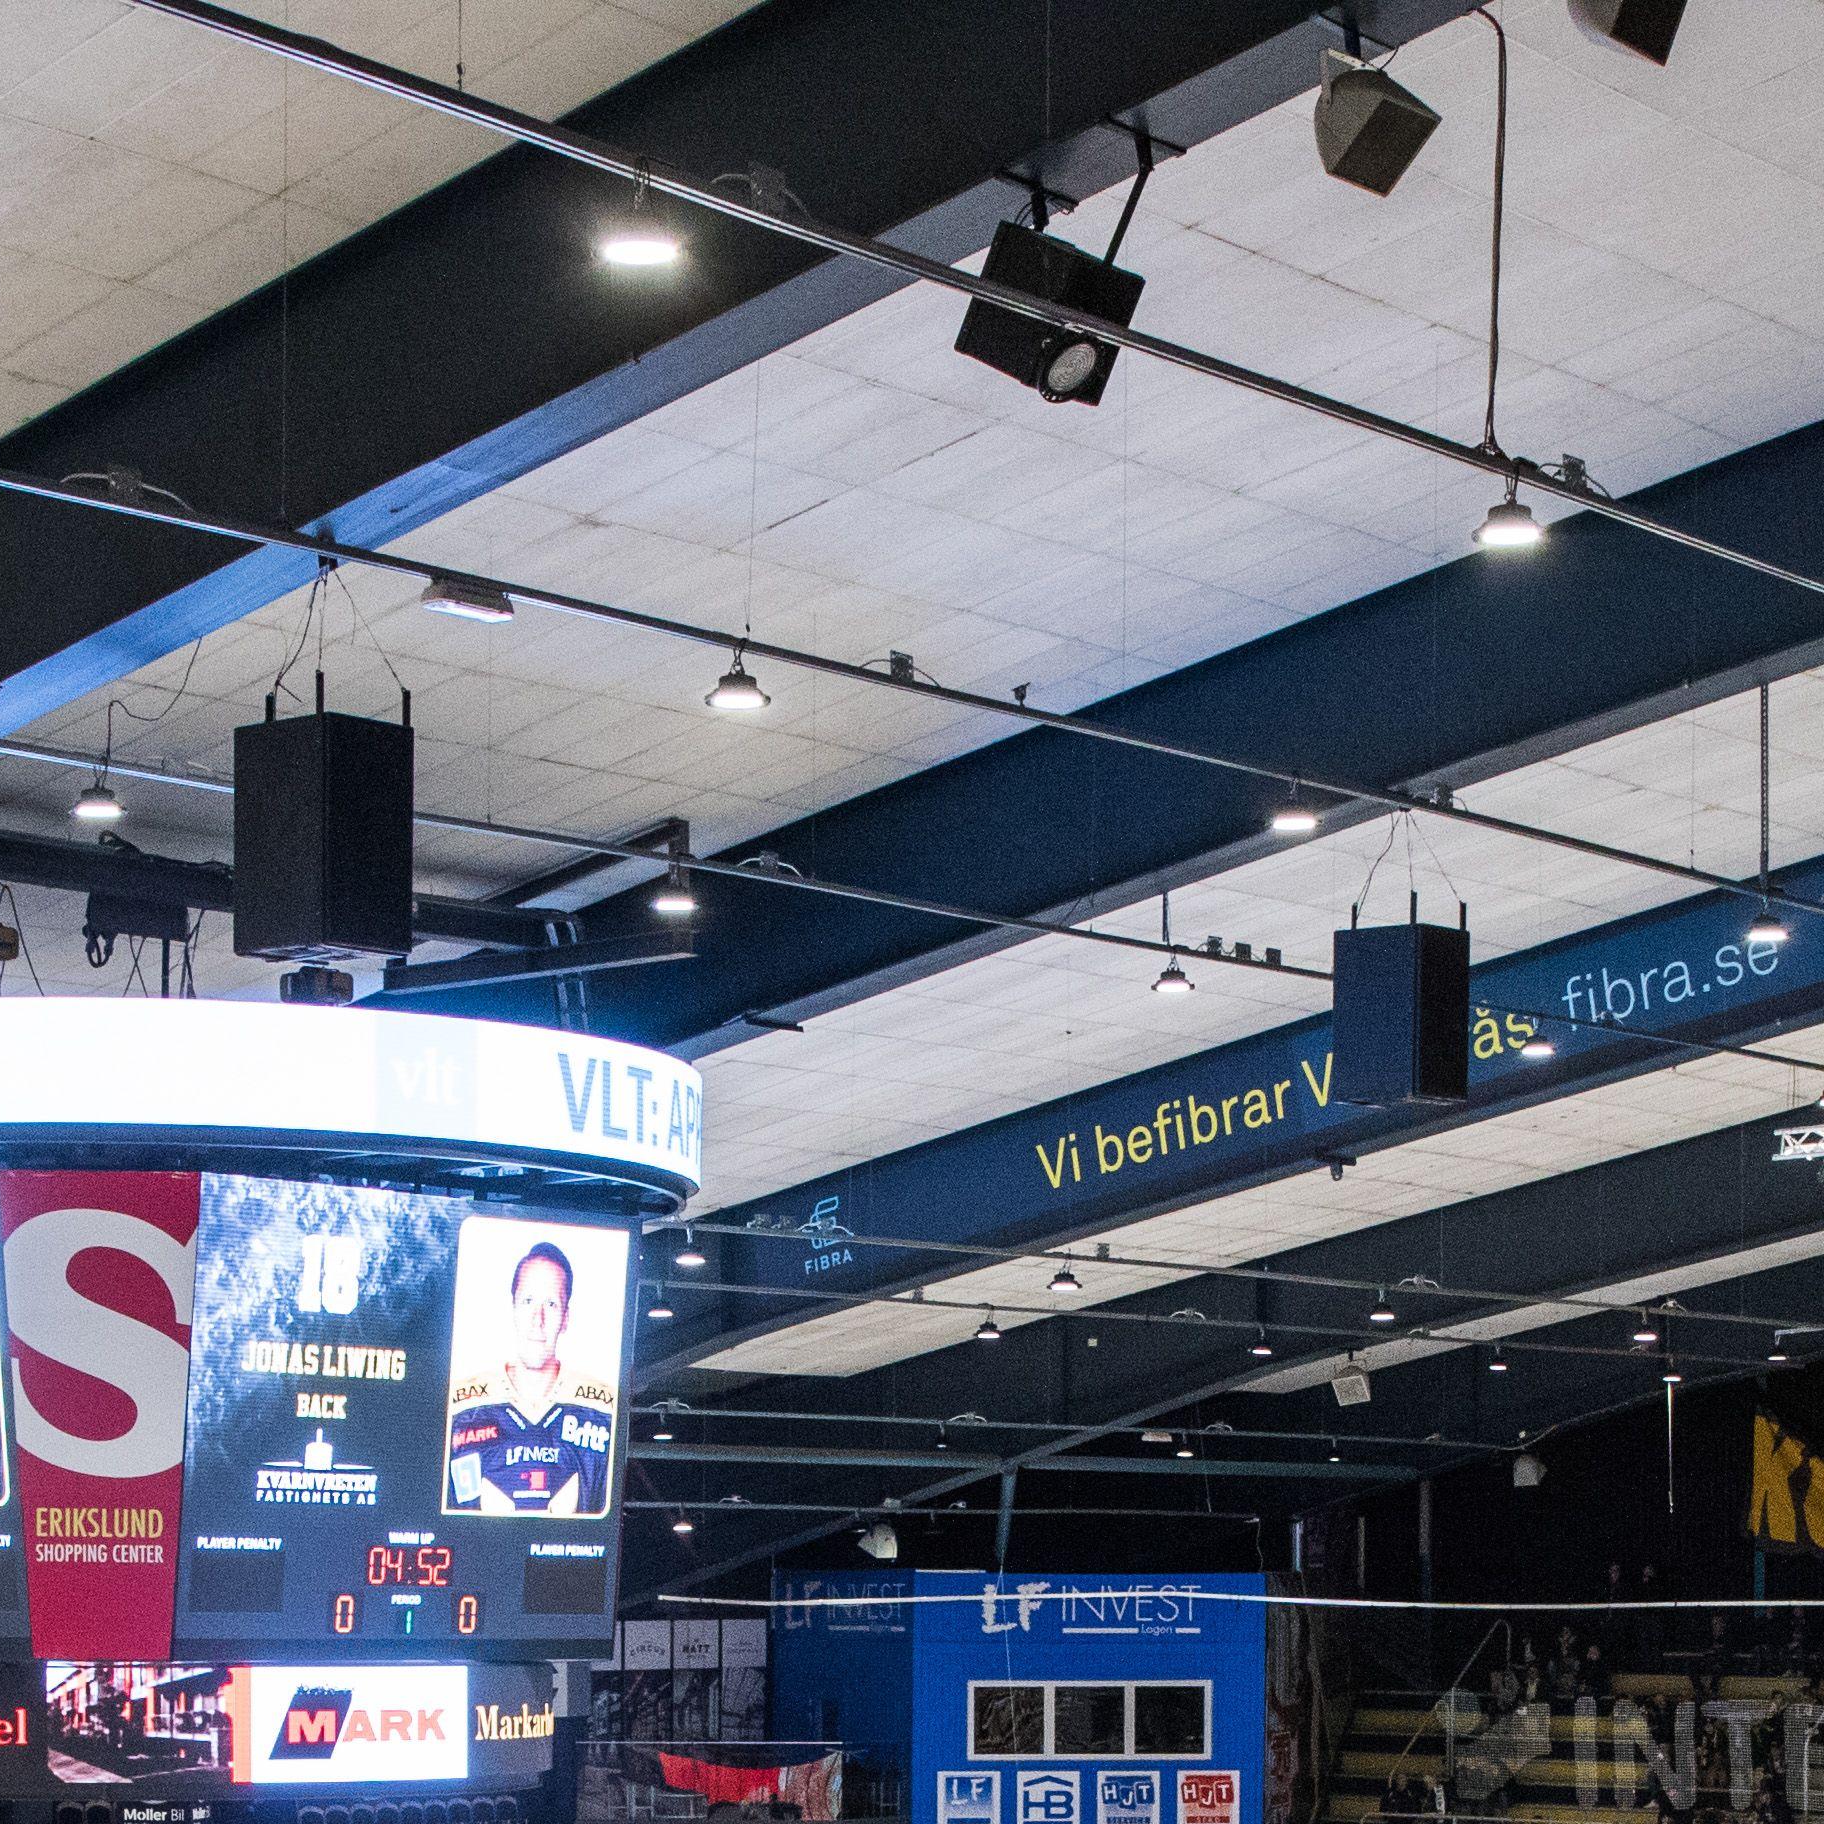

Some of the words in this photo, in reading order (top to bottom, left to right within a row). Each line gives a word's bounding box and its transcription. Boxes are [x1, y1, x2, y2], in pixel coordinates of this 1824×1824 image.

[1561, 934, 1780, 1034] fibra.se
[558, 1053, 657, 1146] VLT:
[1036, 1134, 1079, 1189] Vi
[1097, 1078, 1292, 1175] befibrar
[298, 1234, 359, 1314] 18
[804, 1248, 853, 1275] FIBRA
[242, 1342, 319, 1378] JONAS
[322, 1345, 406, 1381] LIWING
[296, 1393, 347, 1420] BACK
[575, 1385, 614, 1406] ABAX
[452, 1425, 498, 1447] MARK
[256, 1491, 351, 1505] FASTIGHETS
[35, 1506, 164, 1540] ERIKSLUND
[35, 1543, 107, 1563] SHOPPING
[111, 1542, 164, 1562] CENTER
[197, 1537, 236, 1550] PLAYER
[237, 1538, 282, 1551] PENALTY
[530, 1545, 565, 1556] PLAYER
[566, 1545, 605, 1557] PENALTY
[368, 1547, 452, 1586] 04:52
[335, 1595, 354, 1634] 0
[458, 1595, 477, 1634] 0
[982, 1582, 1051, 1633] LF
[1062, 1585, 1202, 1621] INVEST
[286, 1707, 447, 1744] MARK
[951, 1778, 986, 1804] LF
[171, 1808, 185, 1821] Bil
